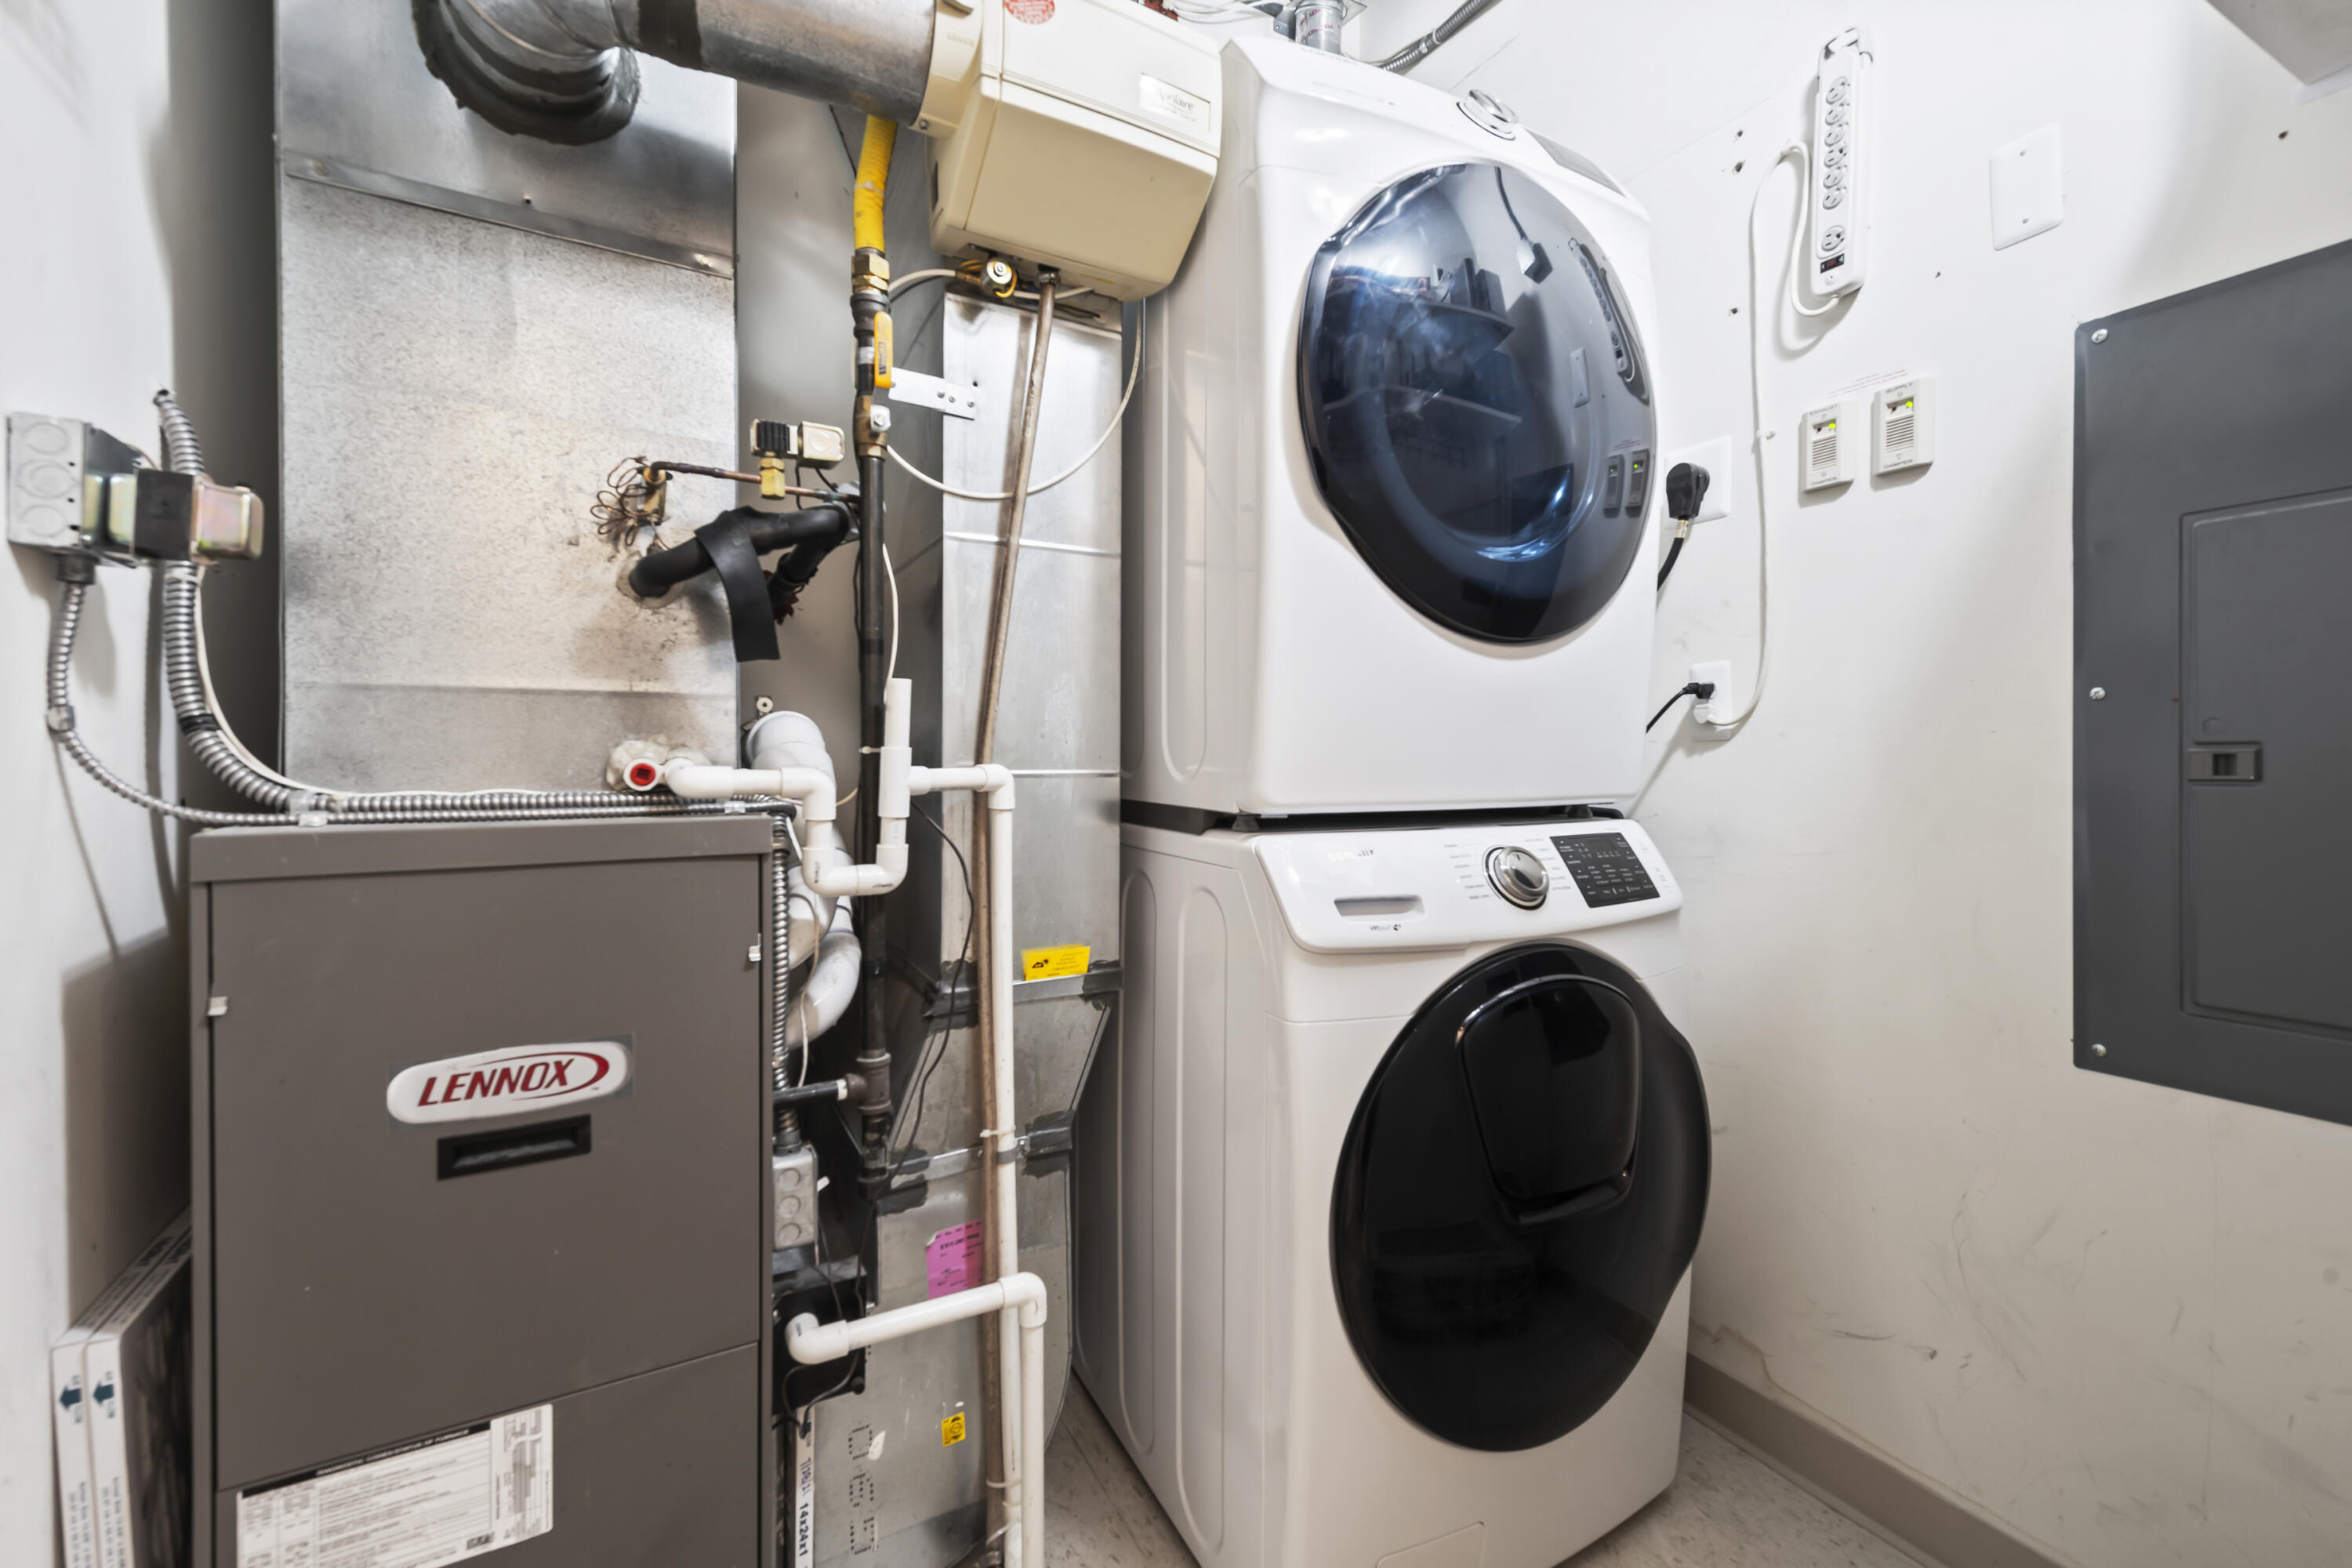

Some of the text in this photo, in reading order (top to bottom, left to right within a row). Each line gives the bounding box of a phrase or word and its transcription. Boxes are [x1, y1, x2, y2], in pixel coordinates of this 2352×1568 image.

[1886, 382, 1914, 394] SUPPLY
[417, 1058, 574, 1107] LENNOX
[798, 1502, 809, 1557] 14x24x1
